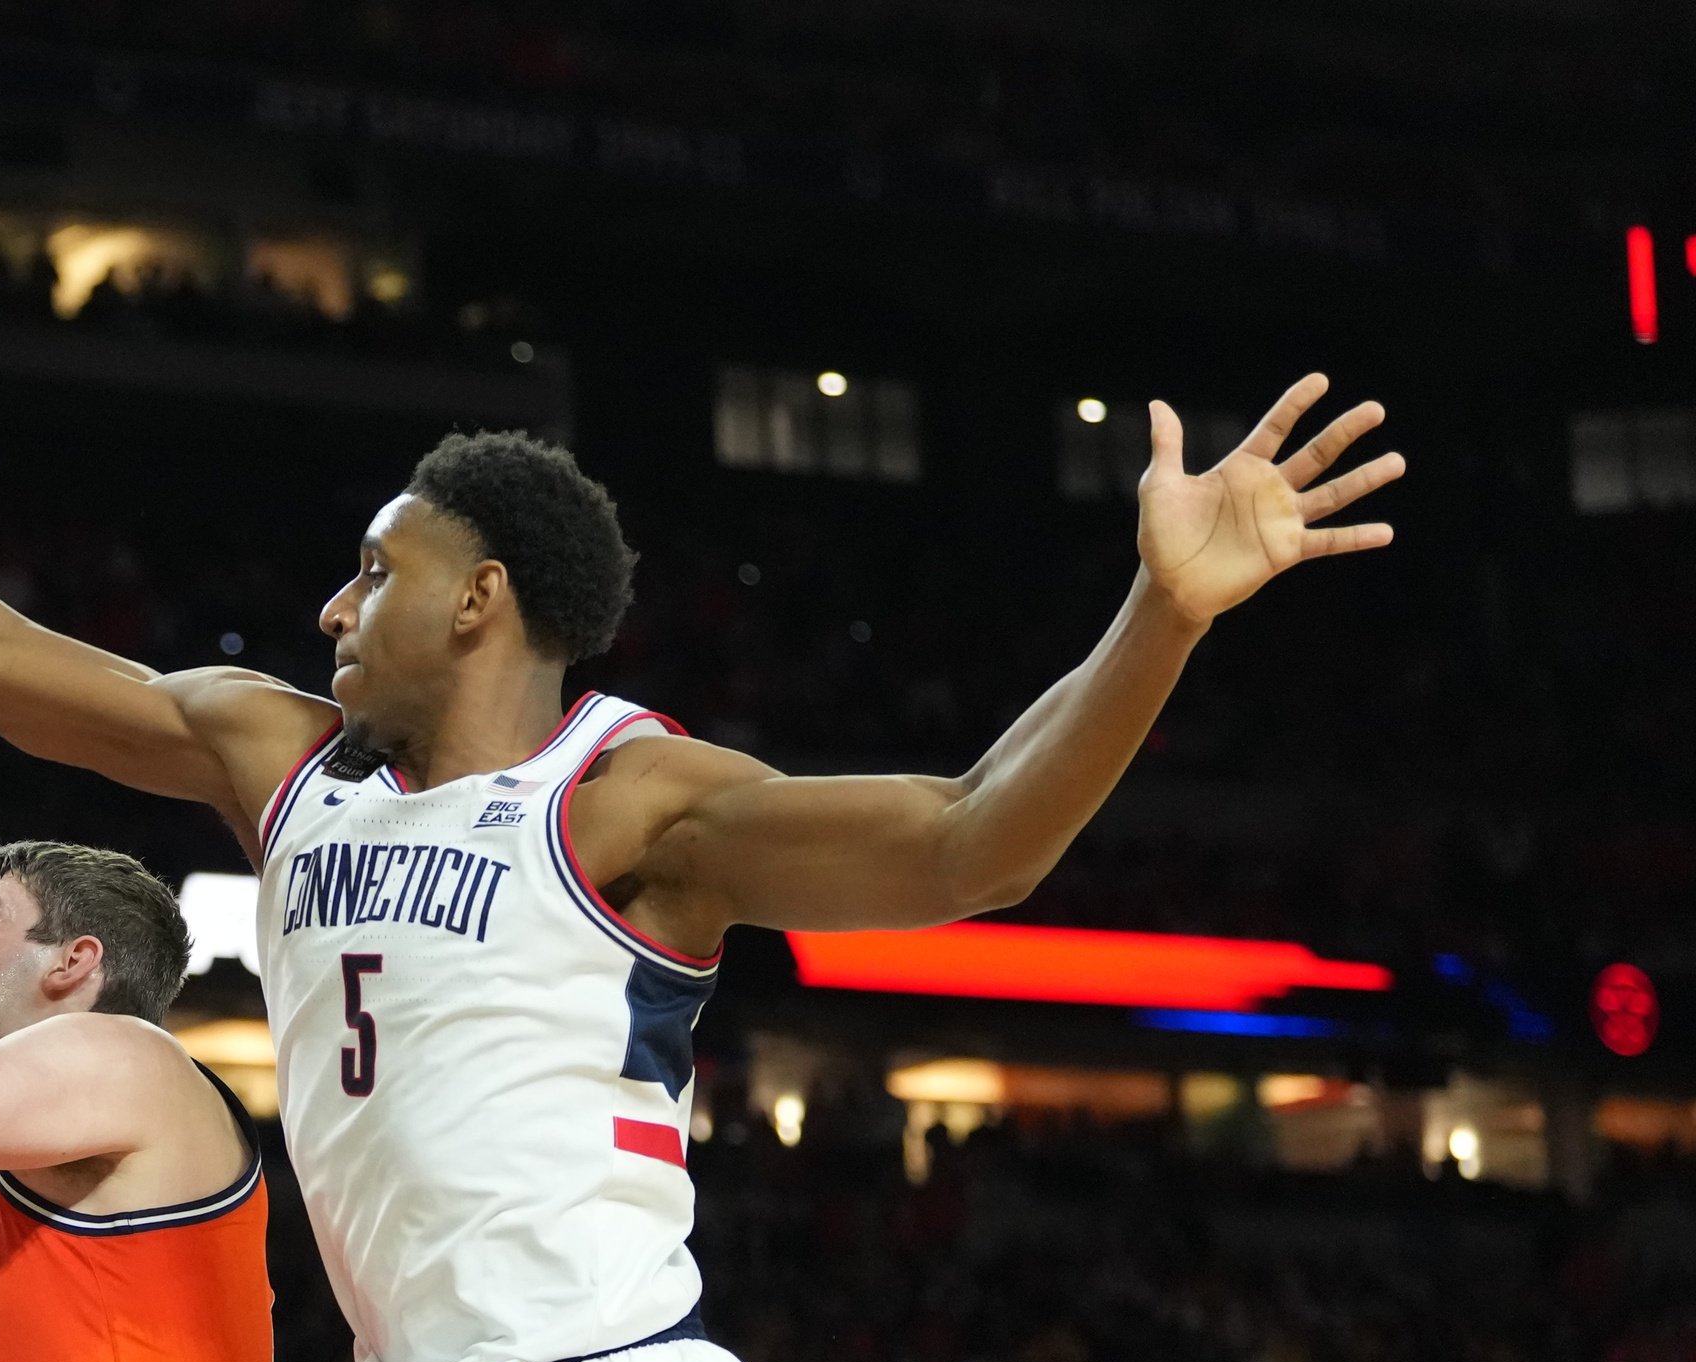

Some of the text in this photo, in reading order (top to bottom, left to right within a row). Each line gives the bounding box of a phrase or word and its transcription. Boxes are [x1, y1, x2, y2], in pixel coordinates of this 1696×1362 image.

[331, 761, 364, 777] FOUR
[485, 801, 522, 812] BIG
[478, 812, 527, 824] EAST
[283, 842, 511, 943] CONNECTICUT
[341, 953, 383, 1097] 5
